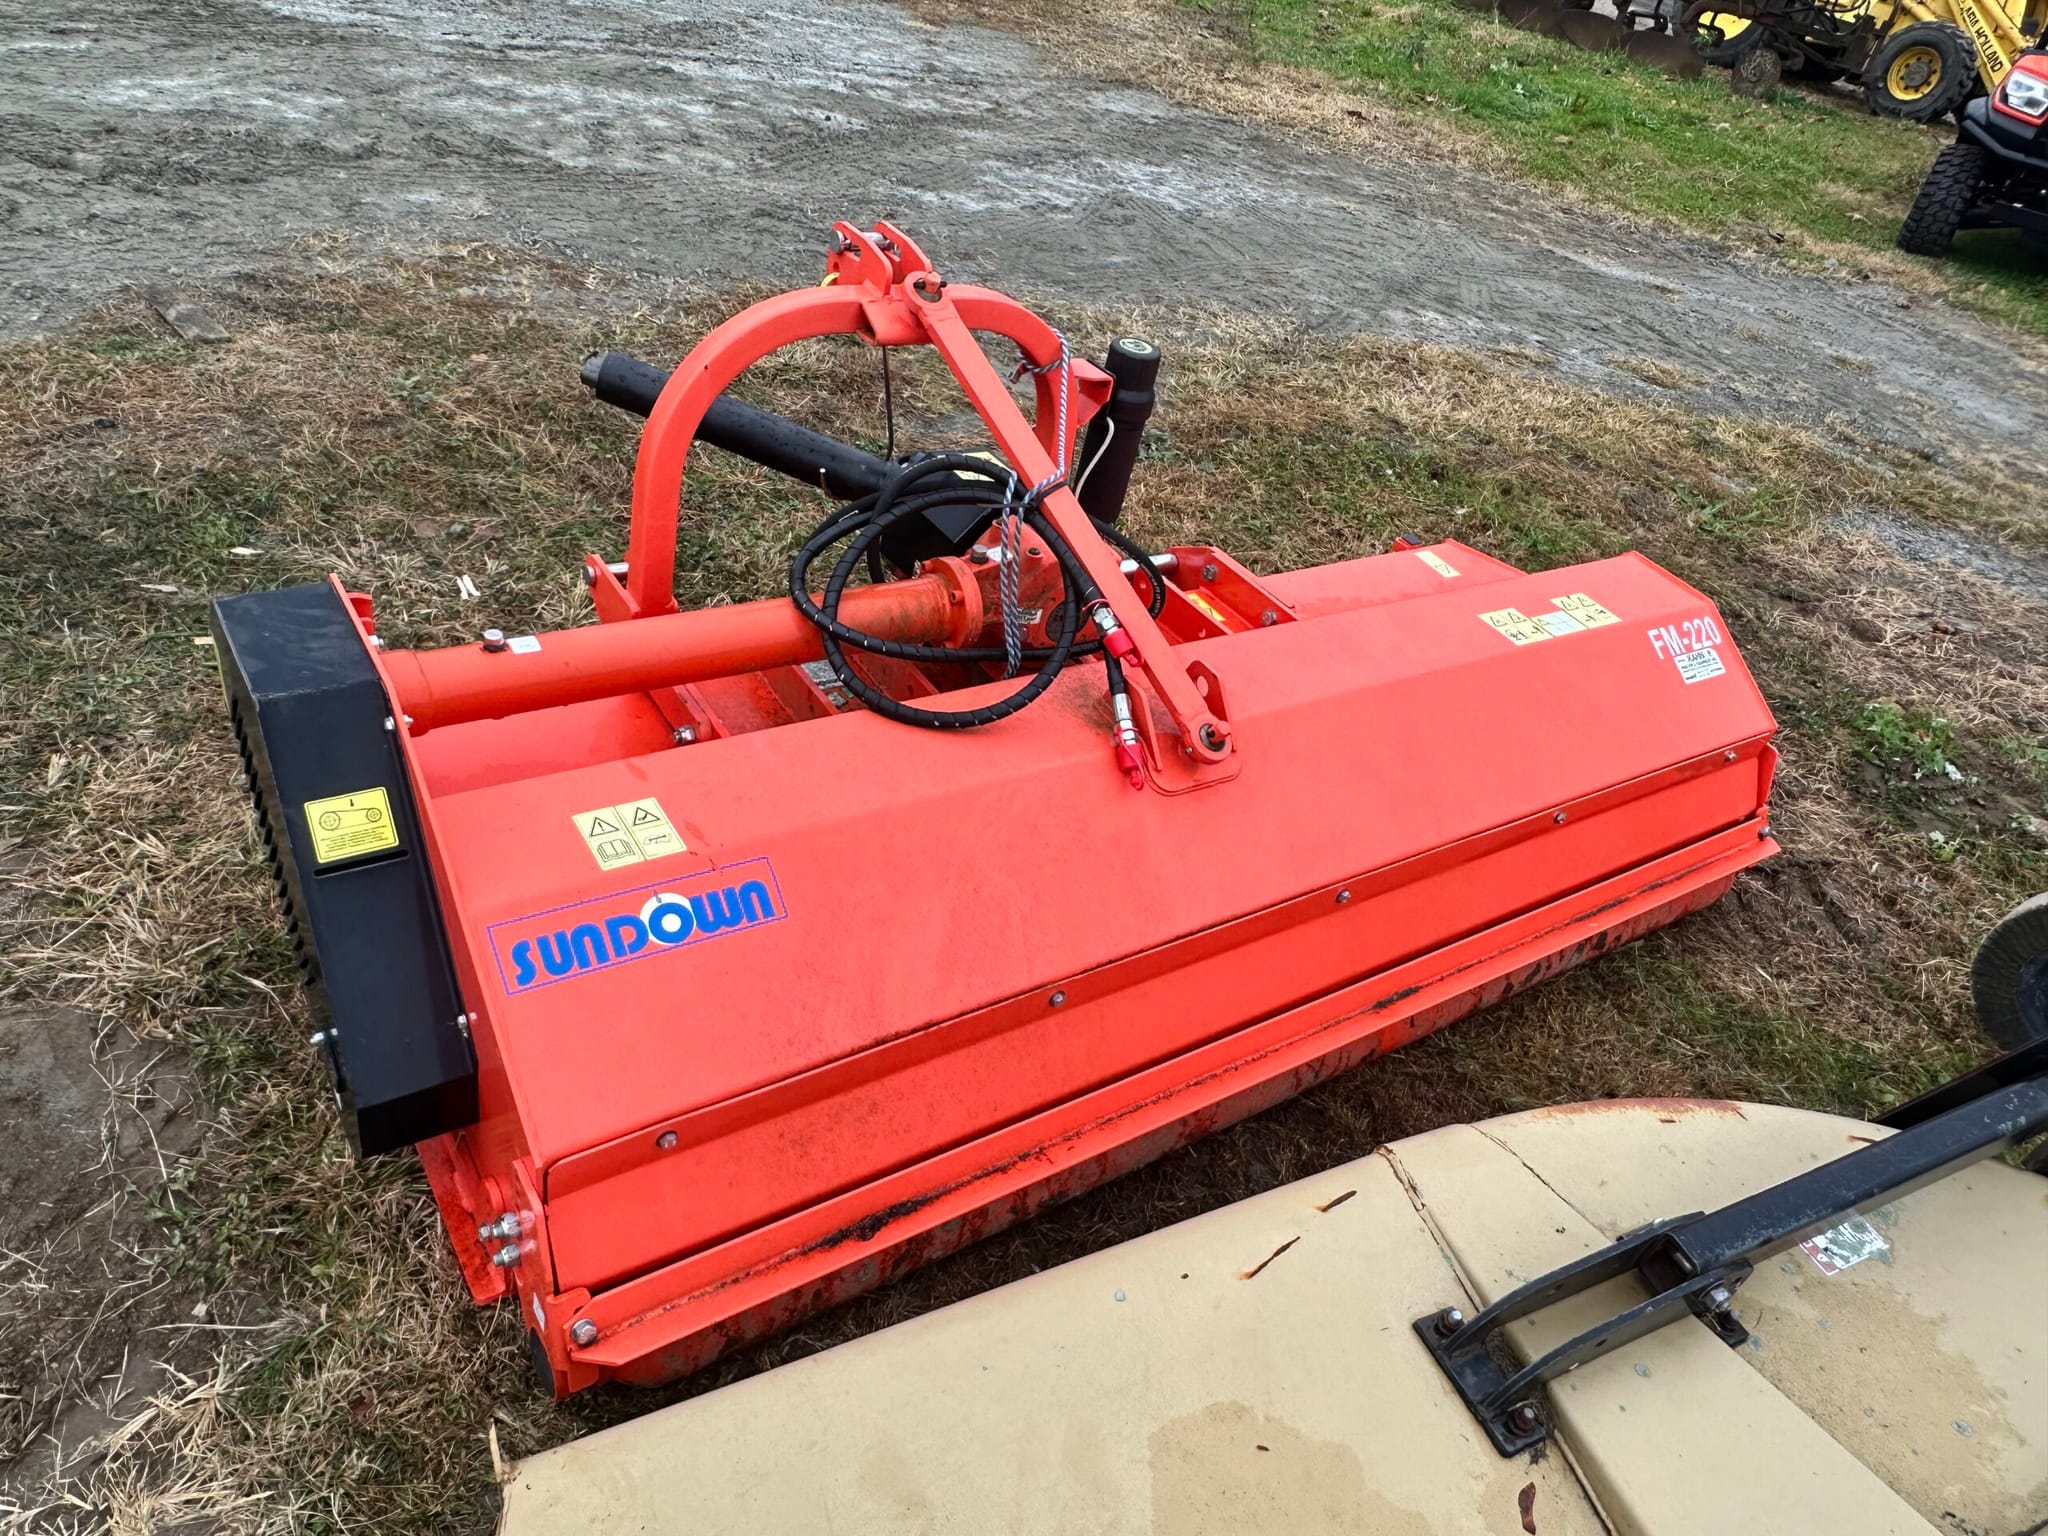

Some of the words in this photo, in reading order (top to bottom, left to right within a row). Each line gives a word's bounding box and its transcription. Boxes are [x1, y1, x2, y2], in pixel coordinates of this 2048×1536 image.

[1975, 27, 2004, 73] HOLLAND
[1648, 617, 1721, 659] FM-220
[511, 879, 776, 986] SUNDOWN
